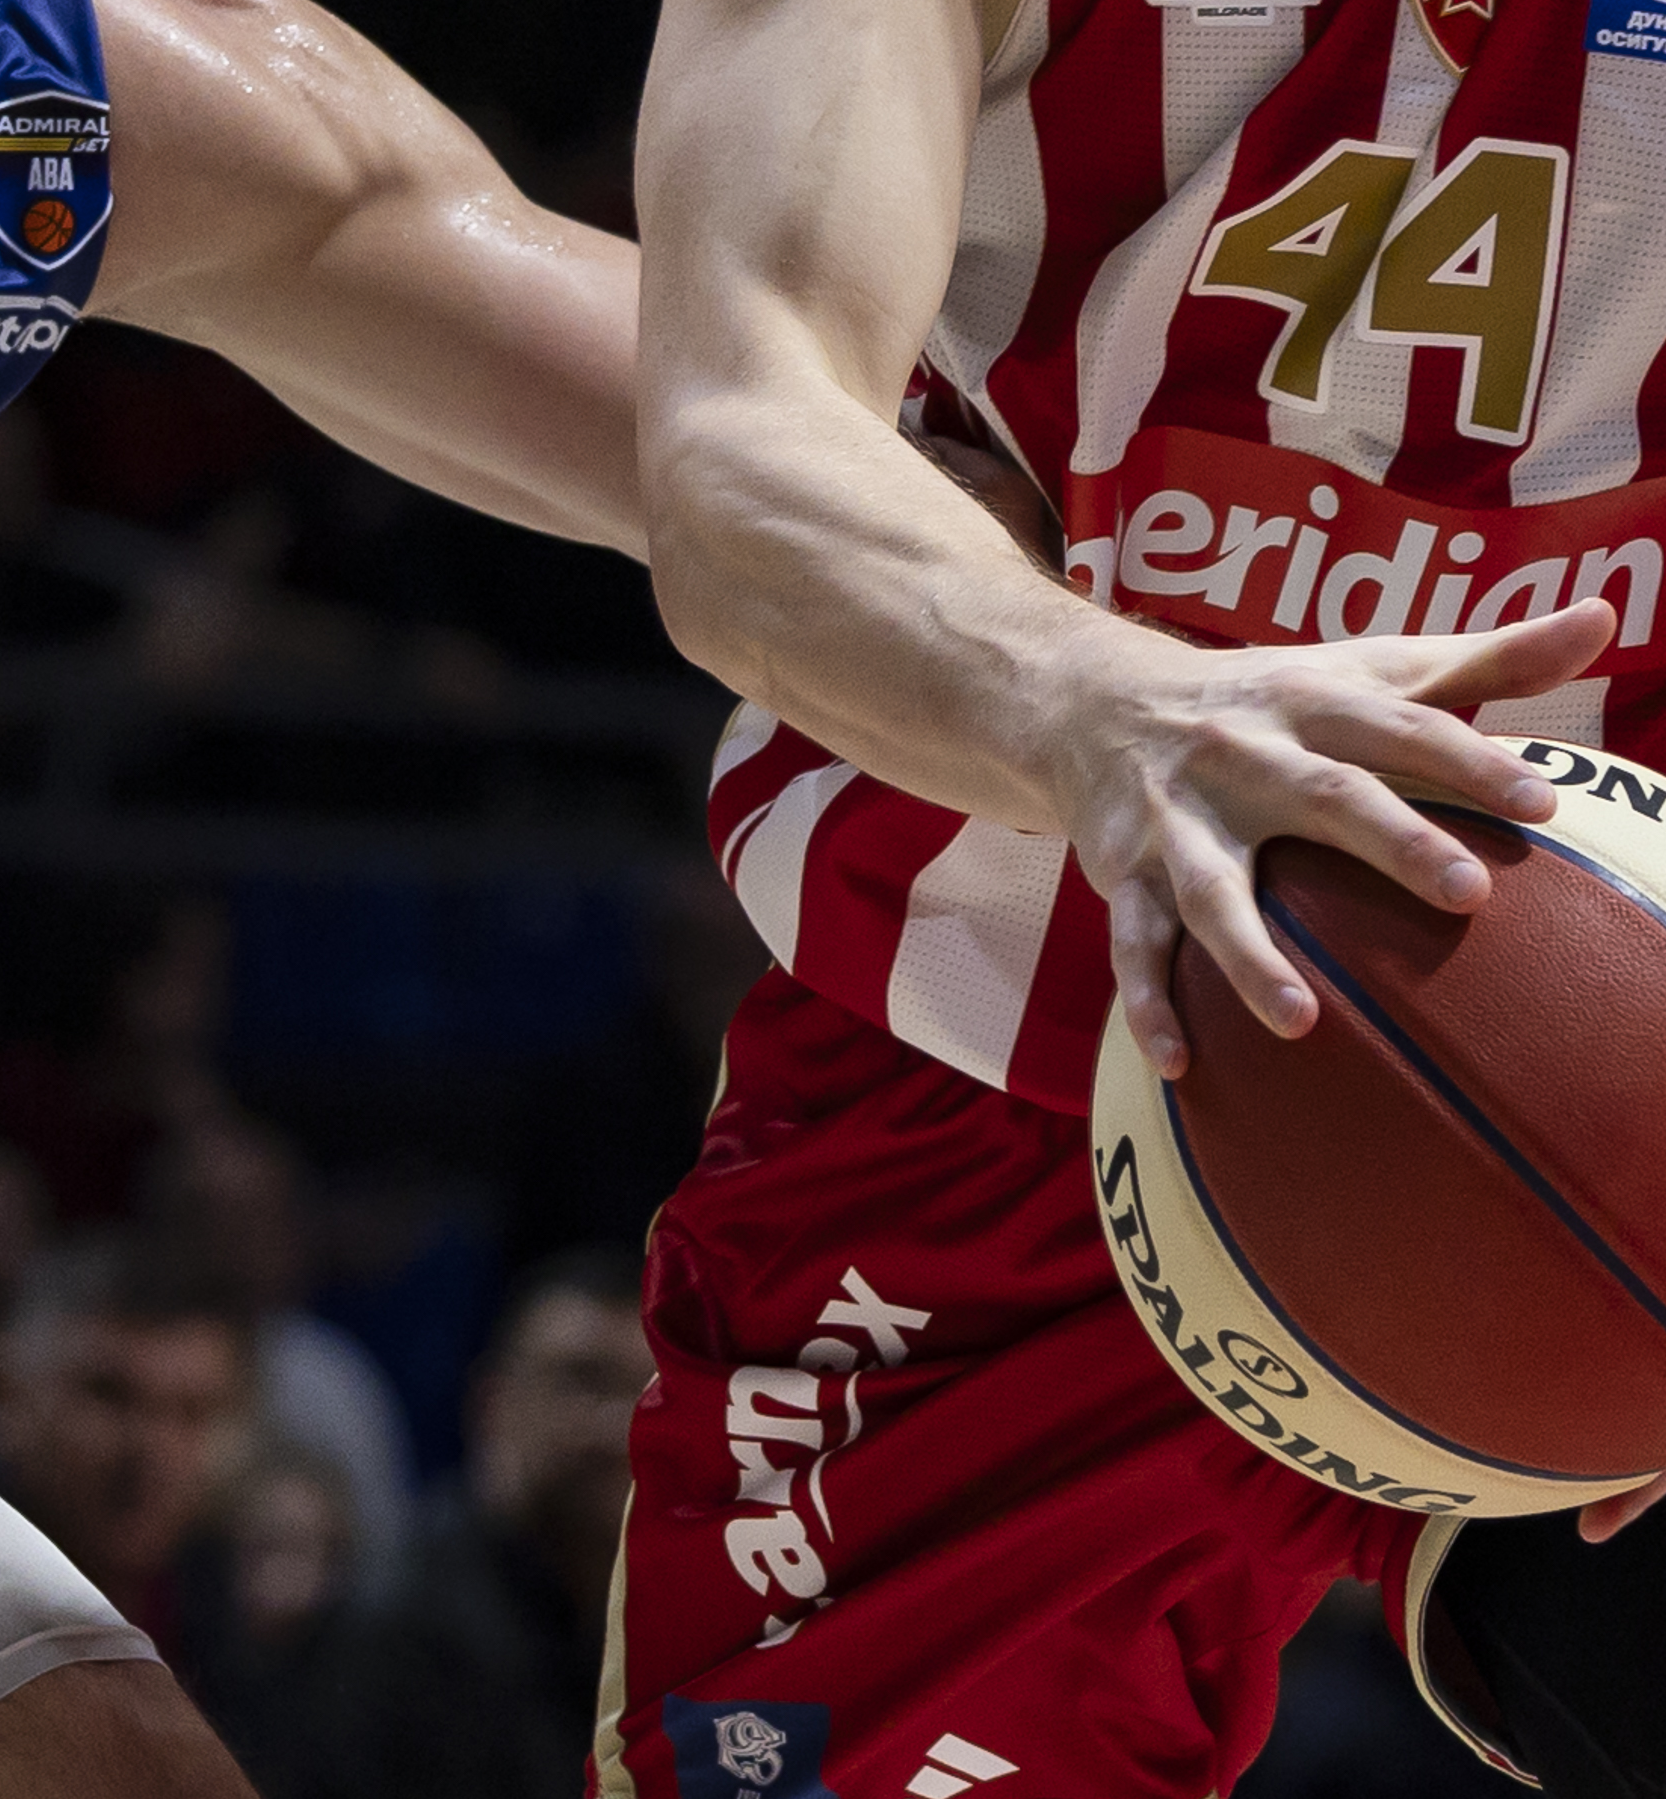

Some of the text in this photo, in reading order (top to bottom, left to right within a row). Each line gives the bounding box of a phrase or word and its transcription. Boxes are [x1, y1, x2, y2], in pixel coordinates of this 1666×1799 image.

[1197, 6, 1268, 18] BELGRADE
[26, 156, 76, 192] ABA
[1187, 135, 1572, 448] 44
[1095, 1133, 1478, 1514] SPALDING
